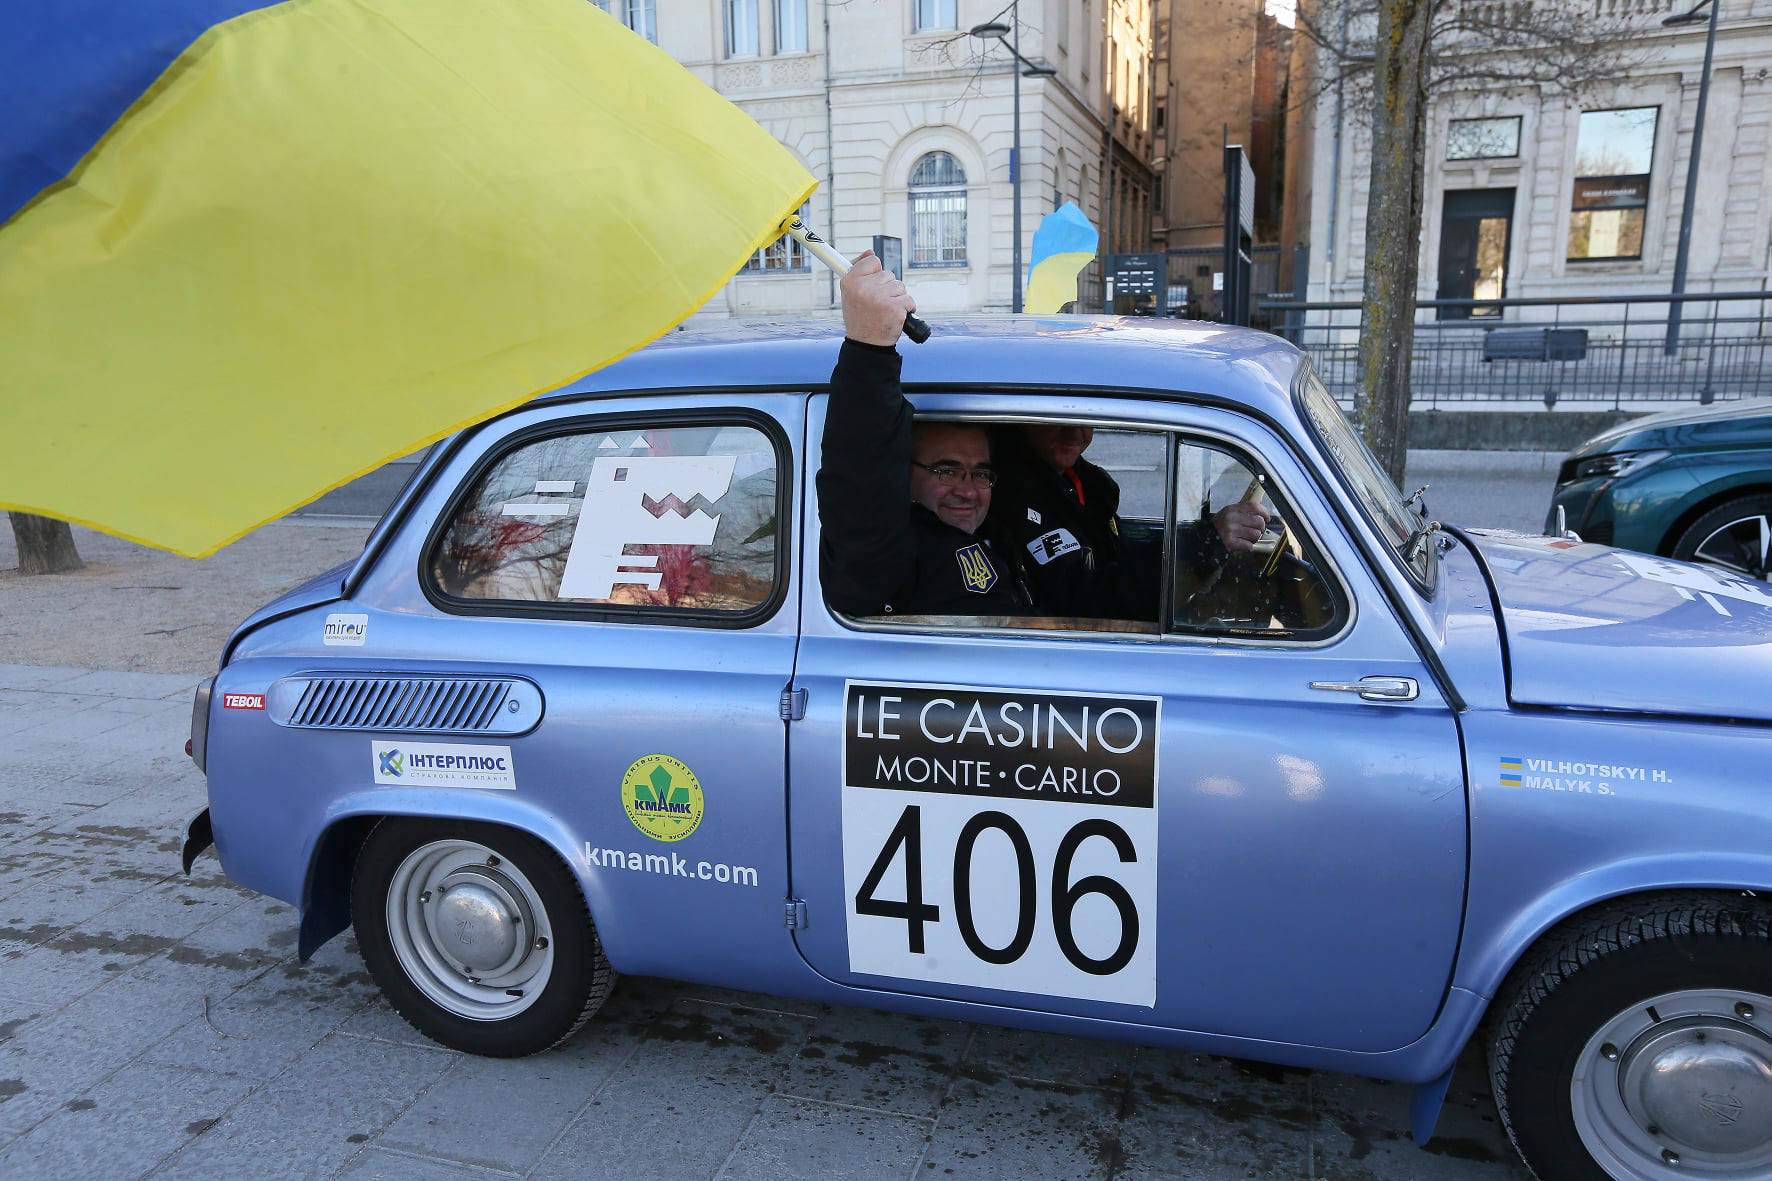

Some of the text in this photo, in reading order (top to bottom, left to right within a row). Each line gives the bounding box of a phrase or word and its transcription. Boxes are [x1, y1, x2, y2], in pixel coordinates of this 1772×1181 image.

[225, 695, 263, 708] TEBOIL
[857, 695, 1143, 754] LE CASINO
[409, 753, 506, 771] ІНТЕРПЛЮС
[624, 756, 699, 790] VIRIBUS UNITIS
[1526, 758, 1673, 783] VILHOTSKYI H.
[1525, 775, 1615, 796] MALYK S.
[585, 841, 758, 887] kmamk.com
[855, 804, 1140, 975] 406
